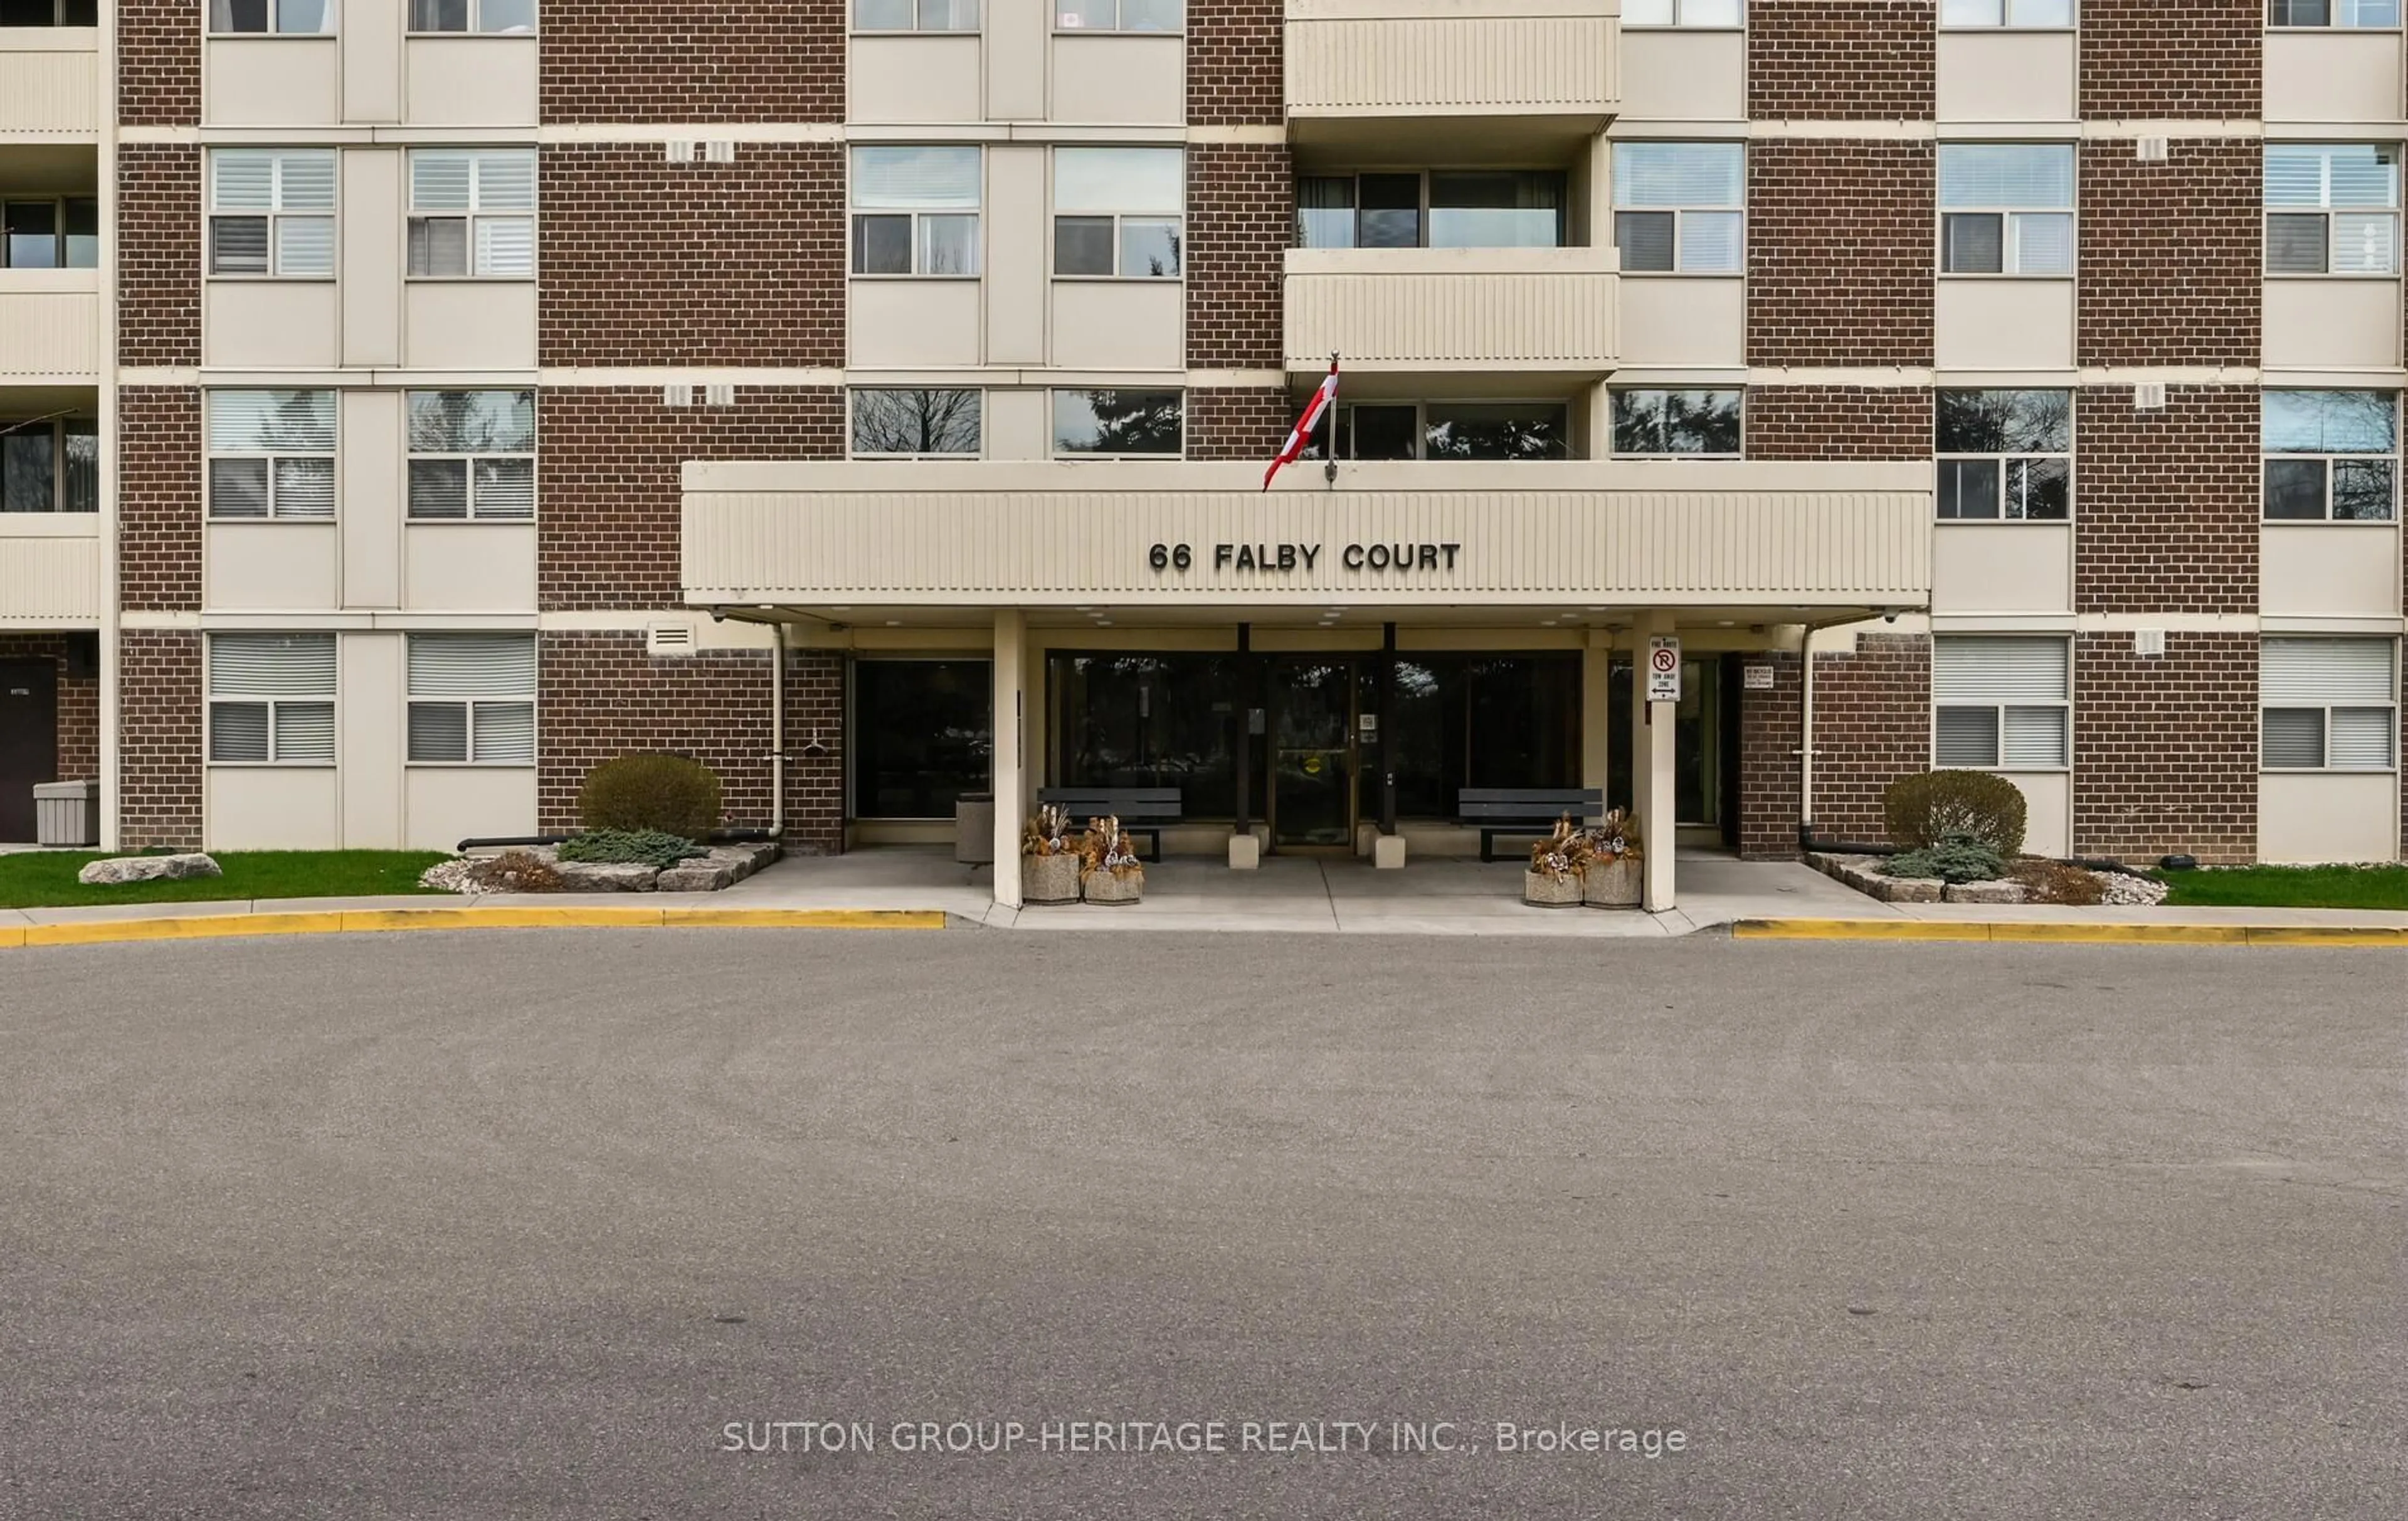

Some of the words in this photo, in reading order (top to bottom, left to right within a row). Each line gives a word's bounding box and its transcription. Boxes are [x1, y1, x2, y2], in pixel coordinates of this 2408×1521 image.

[1149, 544, 1191, 571] 66
[1215, 544, 1321, 571] FALBY
[1343, 544, 1460, 571] COURT
